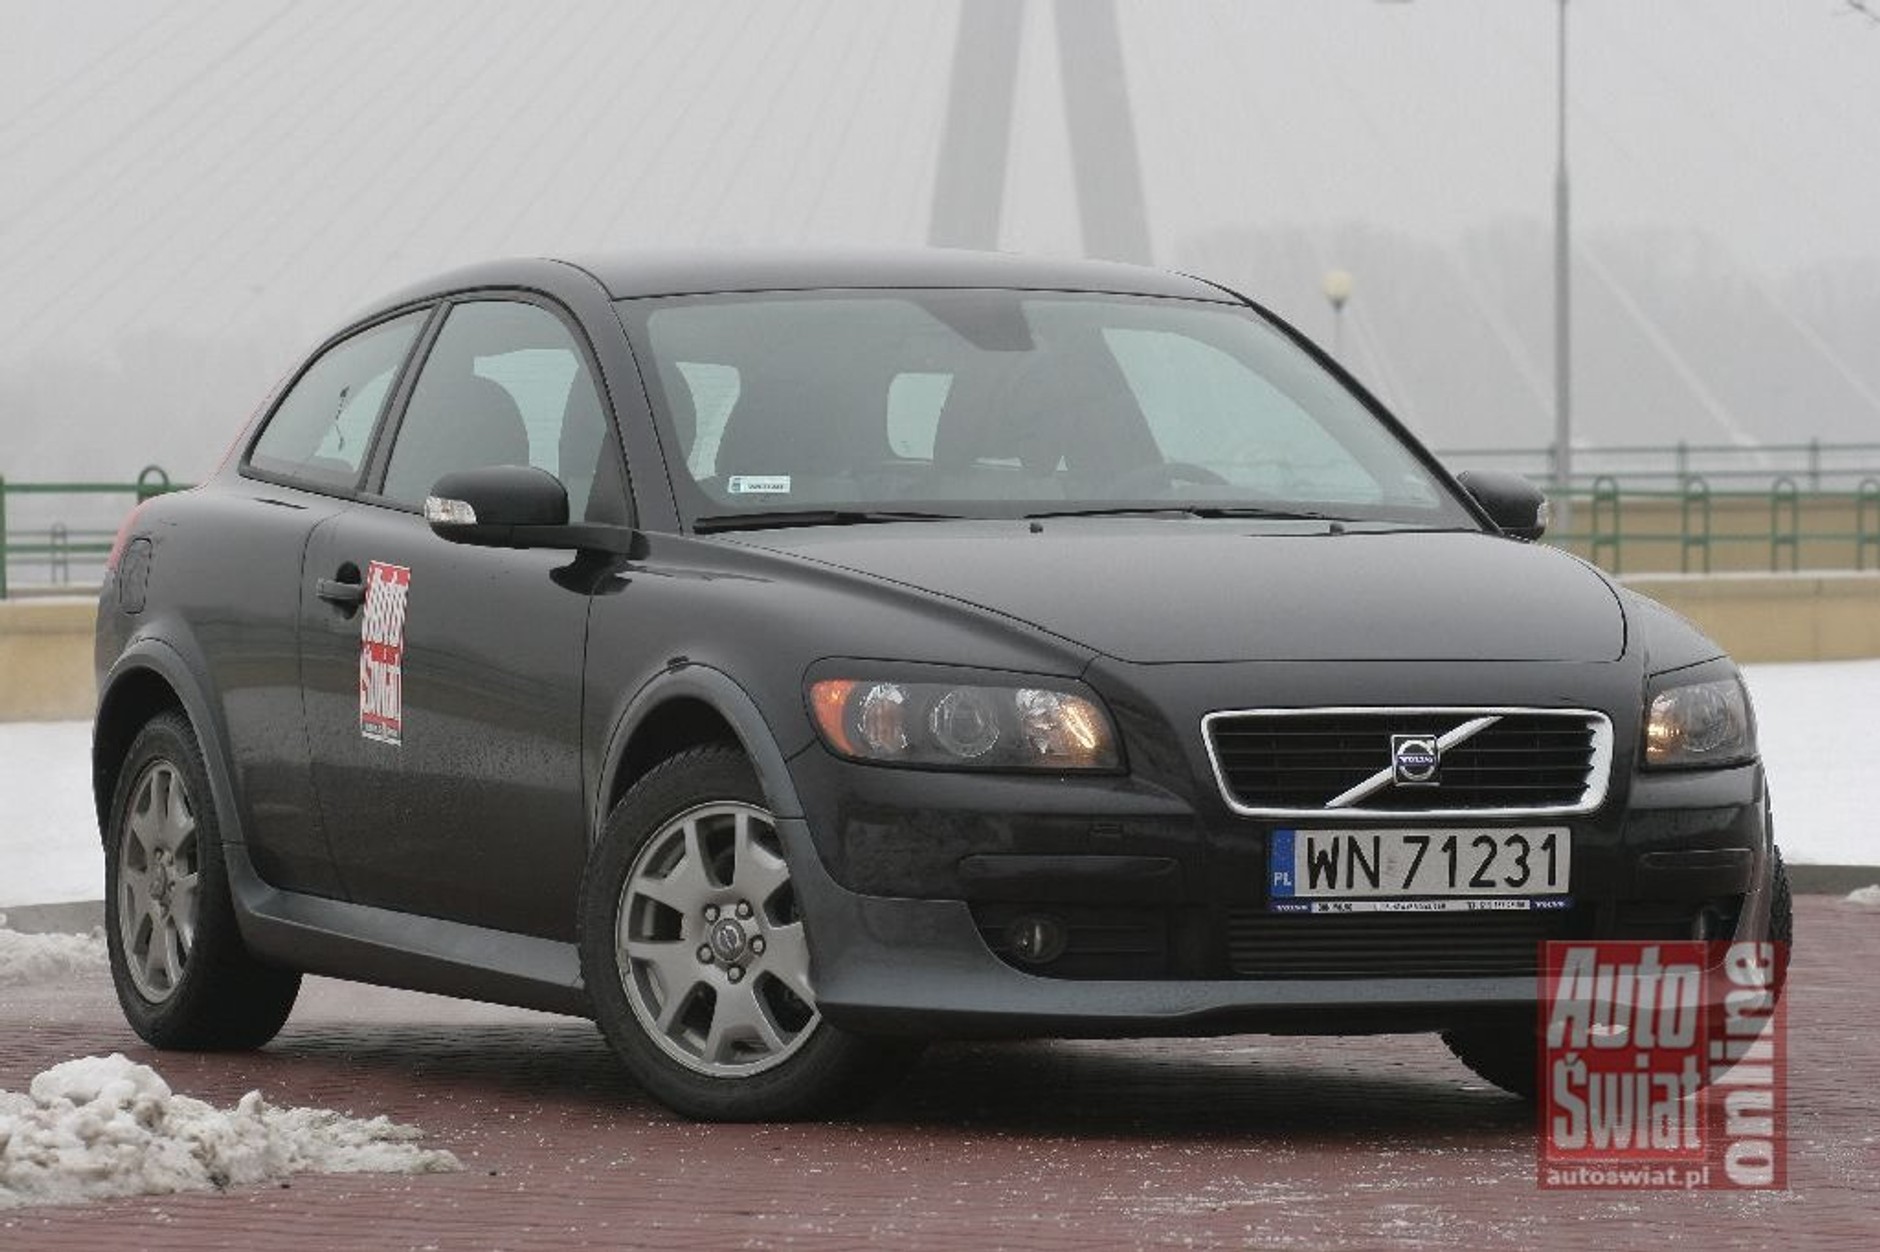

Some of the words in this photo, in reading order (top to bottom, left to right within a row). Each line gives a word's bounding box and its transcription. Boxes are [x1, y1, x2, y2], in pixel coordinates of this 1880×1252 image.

[1273, 871, 1292, 887] PL
[1307, 835, 1380, 889] WN
[1402, 833, 1557, 889] 71231
